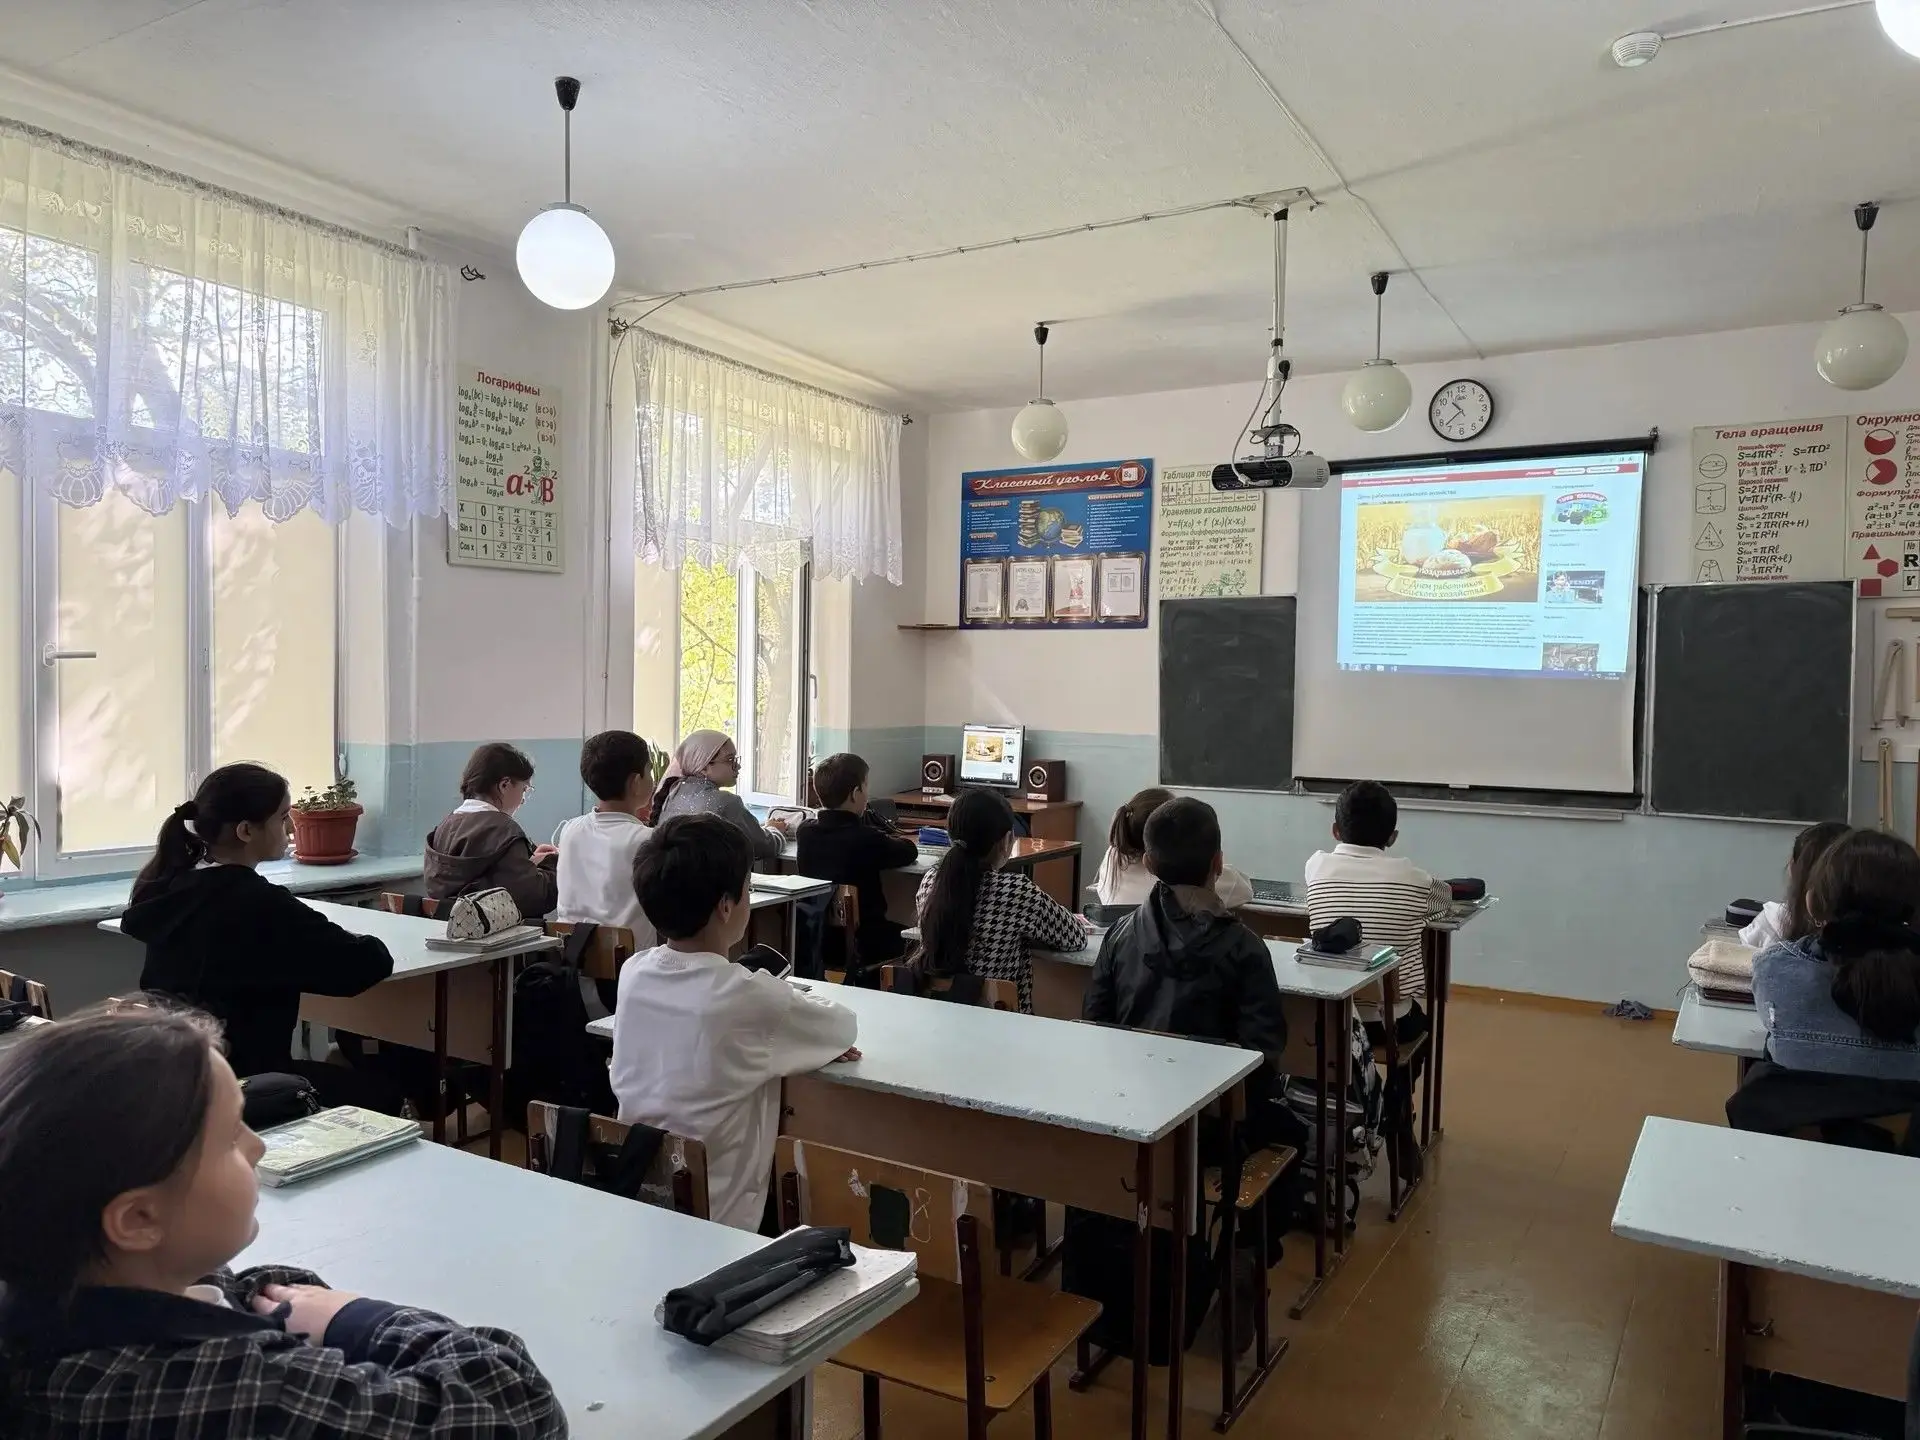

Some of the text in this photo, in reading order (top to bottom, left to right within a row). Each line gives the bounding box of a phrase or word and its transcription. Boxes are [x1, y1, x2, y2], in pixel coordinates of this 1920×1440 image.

[477, 371, 540, 396] Логарифмы
[1447, 390, 1452, 398] 11
[1456, 385, 1466, 393] 12
[1440, 398, 1448, 406] 10
[1478, 394, 1484, 402] 2
[1482, 404, 1488, 412] 3
[1459, 428, 1464, 436] 6
[1471, 423, 1476, 431] 5
[1715, 424, 1824, 440] Тела вращения
[974, 470, 1111, 490] Классный уголок
[1163, 470, 1195, 480] Таблица
[481, 505, 486, 516] 0
[1161, 502, 1256, 518] Уравнение касательной
[481, 524, 486, 536] 0
[1852, 530, 1916, 540] Правильные
[1433, 580, 1483, 591] работников
